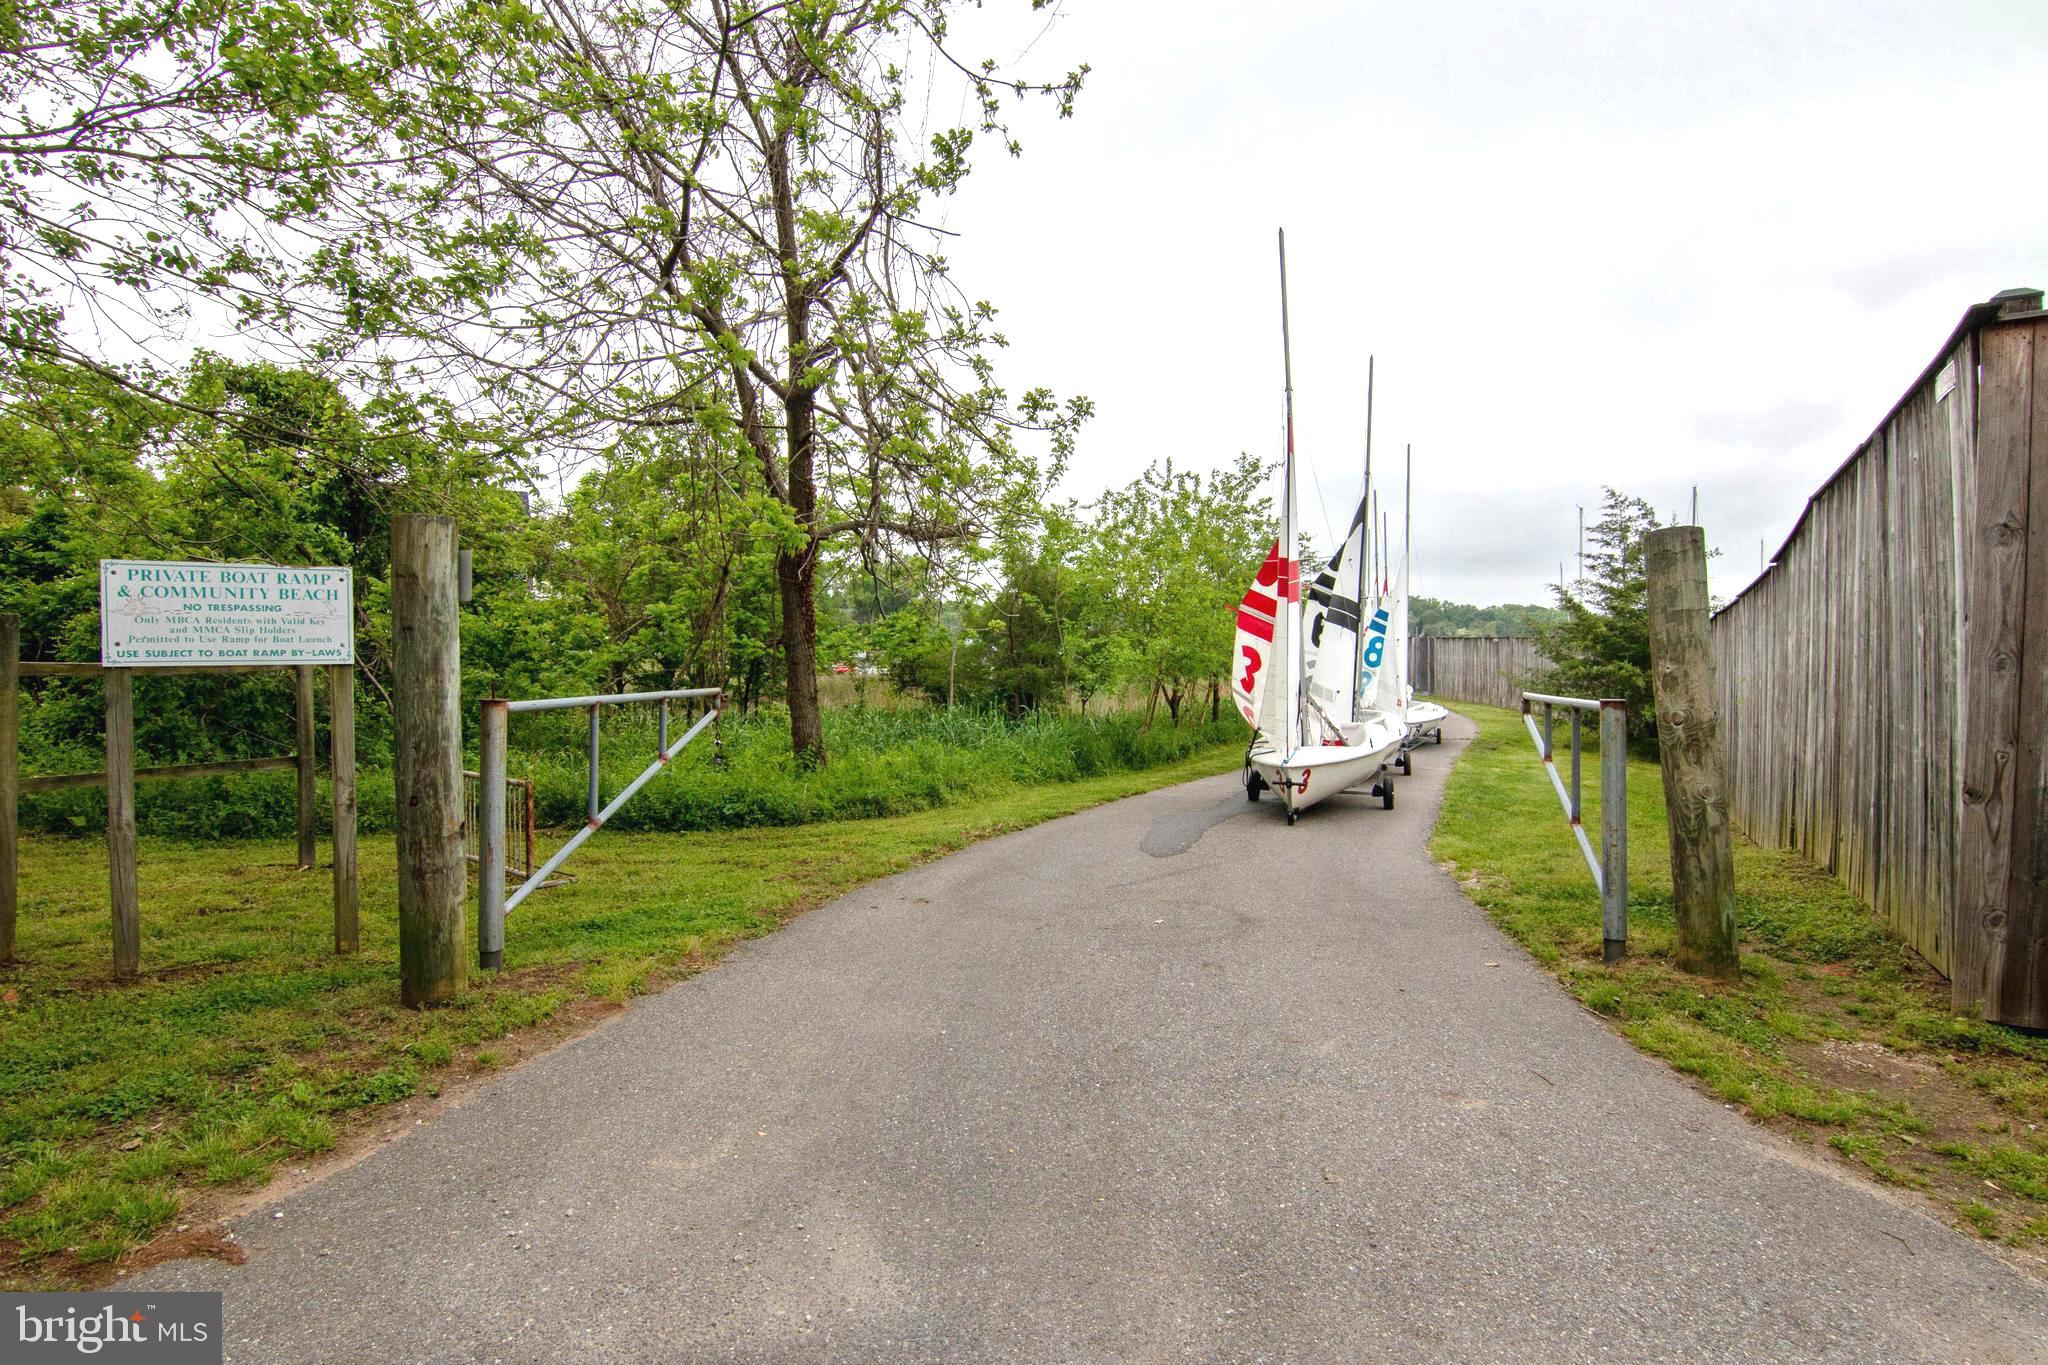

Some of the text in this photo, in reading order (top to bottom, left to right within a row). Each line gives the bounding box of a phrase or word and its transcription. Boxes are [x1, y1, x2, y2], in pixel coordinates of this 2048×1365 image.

[127, 568, 331, 585] PRIVATE BOAT RAMP
[117, 584, 339, 601] & COMMUNITY BEACH
[183, 603, 282, 612] NO TRESPASSING
[134, 615, 326, 626] Only MBCA Residents with Valid Key
[169, 626, 296, 635] and MMCA Slip Holders
[127, 634, 333, 644] Permitted to Use Ramp for Boat Launch
[116, 649, 342, 658] USE SUBJECT TO BOAT RAMP BY-LAWS
[1240, 645, 1262, 694] 3
[1298, 768, 1311, 795] 3
